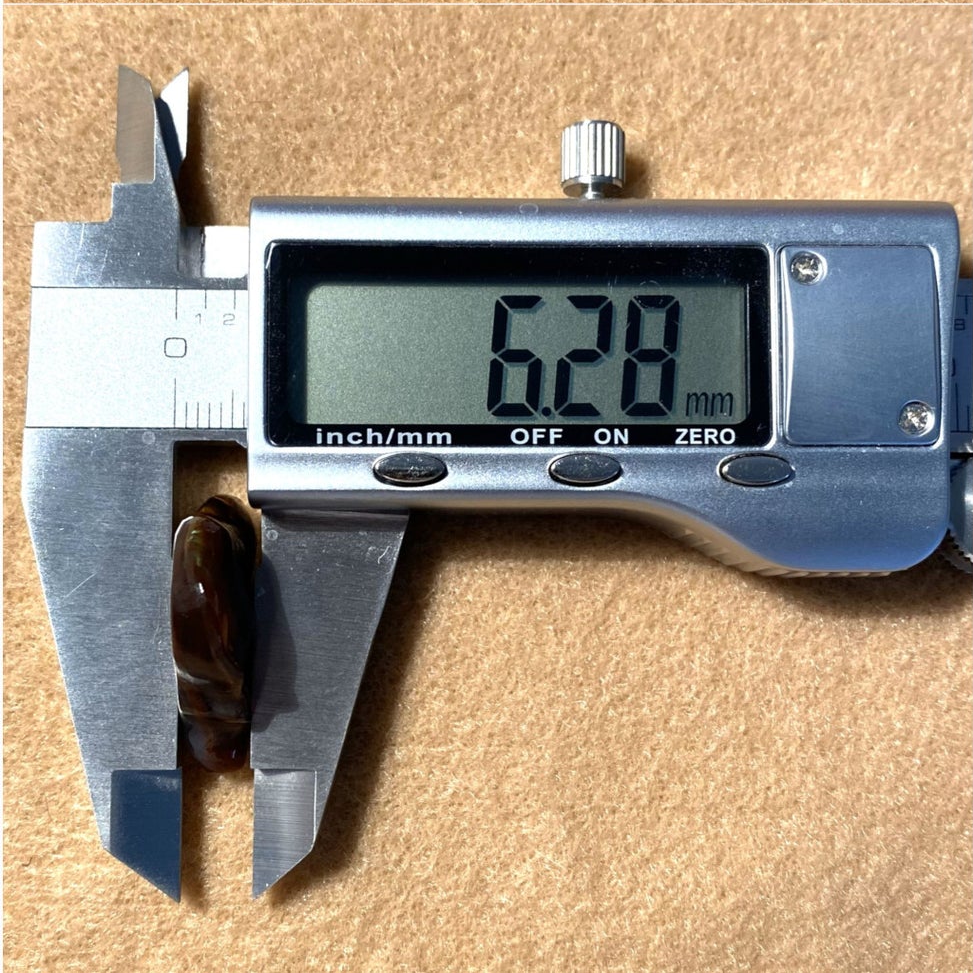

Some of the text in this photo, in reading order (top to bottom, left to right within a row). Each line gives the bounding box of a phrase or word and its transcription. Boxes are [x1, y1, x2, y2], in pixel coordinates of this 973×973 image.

[195, 313, 236, 325] 1 2
[164, 337, 187, 358] 0
[487, 295, 733, 417] 6.28 mm
[316, 428, 736, 445] inch/mm OFF ON ZERO
